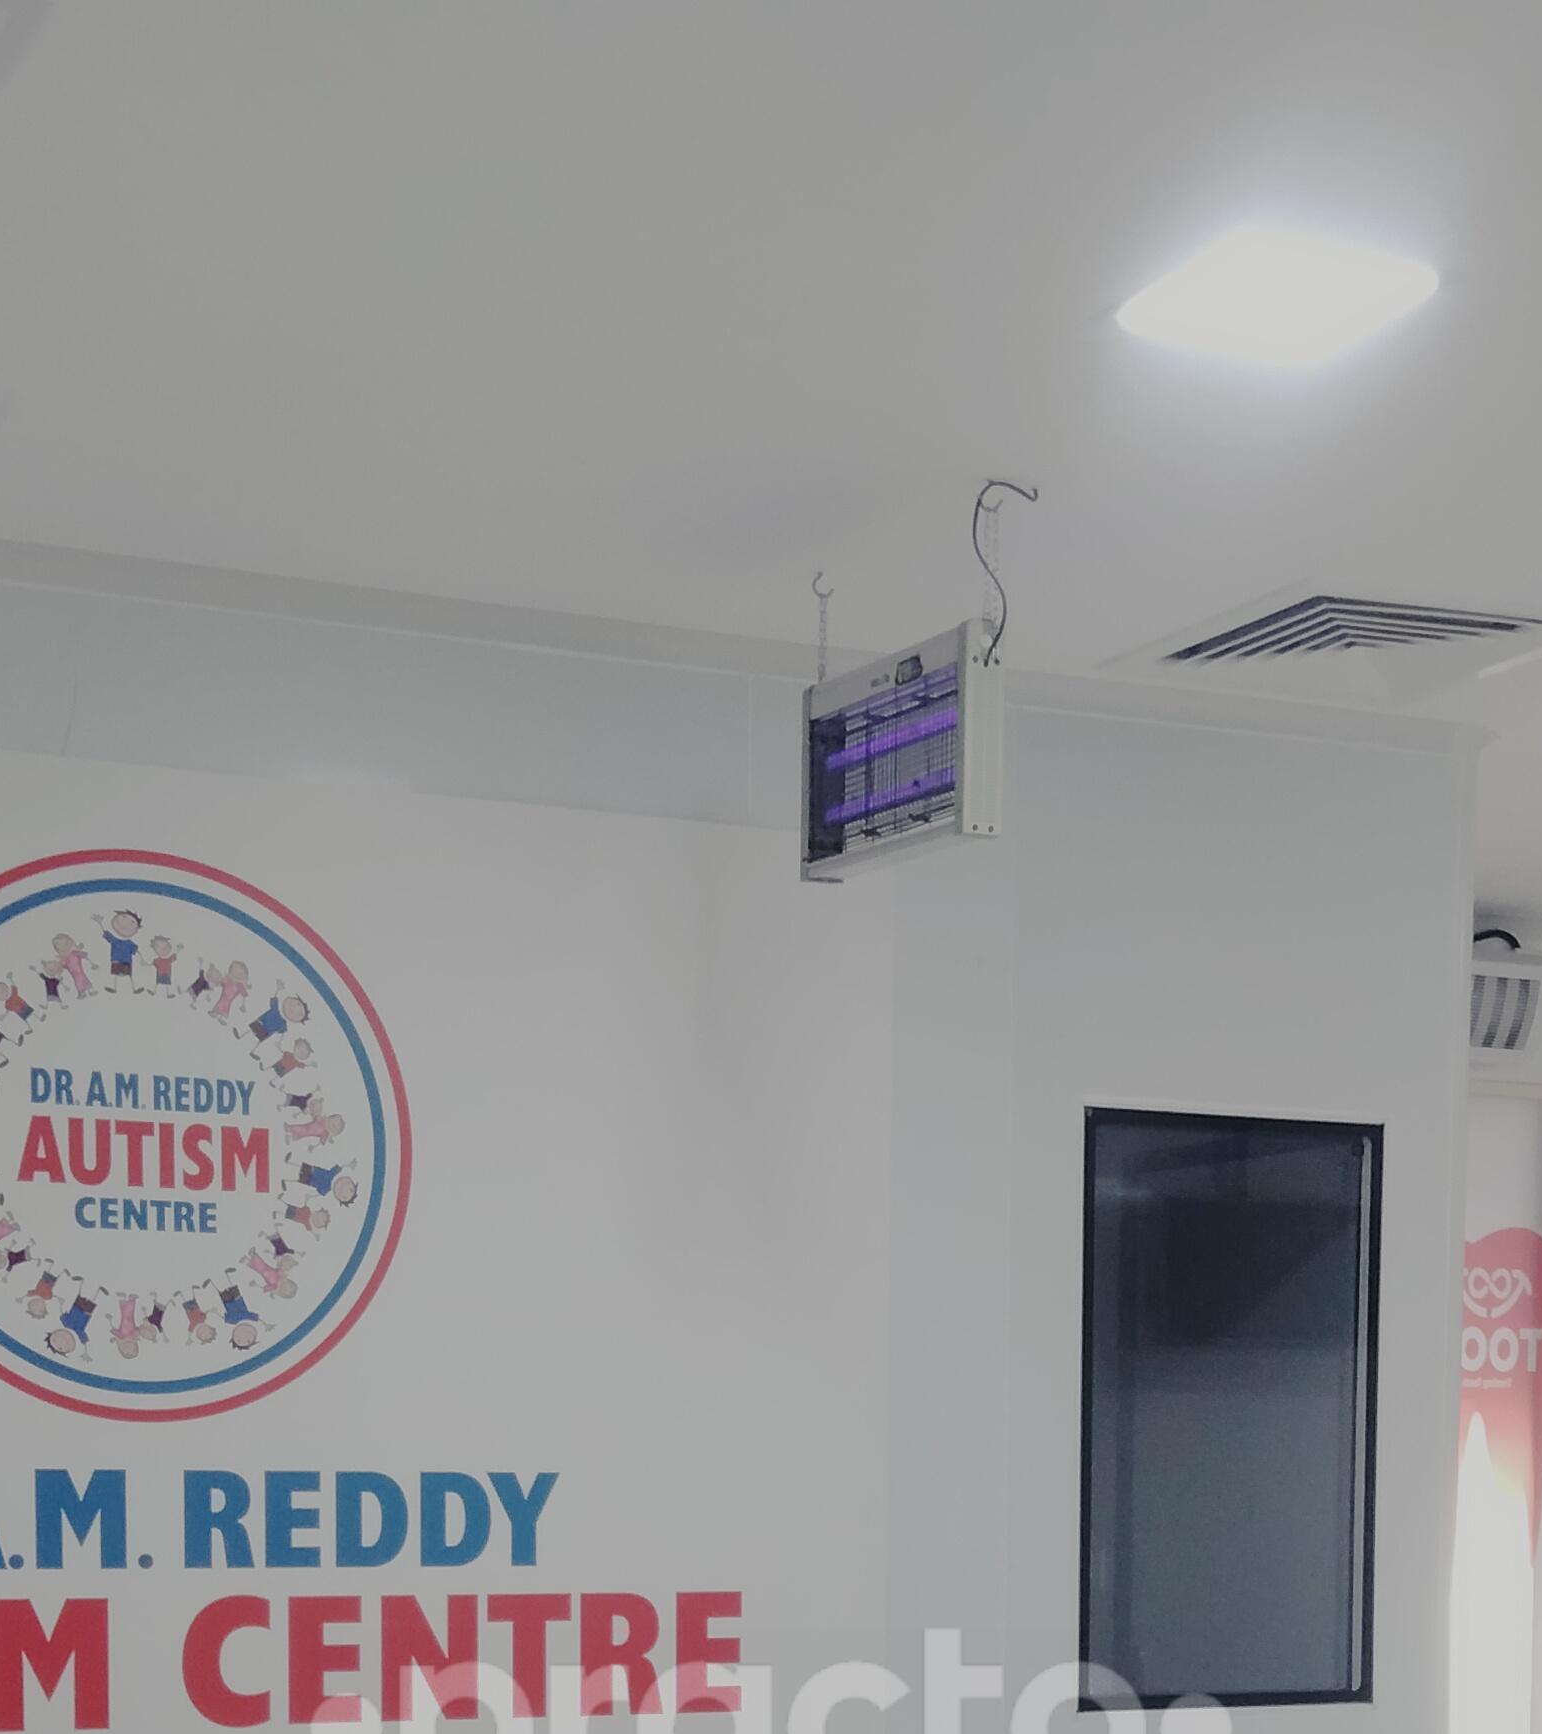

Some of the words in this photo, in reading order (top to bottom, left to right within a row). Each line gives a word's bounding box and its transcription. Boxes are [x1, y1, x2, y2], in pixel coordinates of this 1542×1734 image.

[30, 1067, 80, 1106] DR.
[153, 1075, 256, 1116] REDDY
[17, 1115, 270, 1193] AUTISM
[74, 1196, 217, 1234] CENTRE
[182, 1470, 562, 1570] REDDY
[181, 1591, 743, 1729] CENTRE
